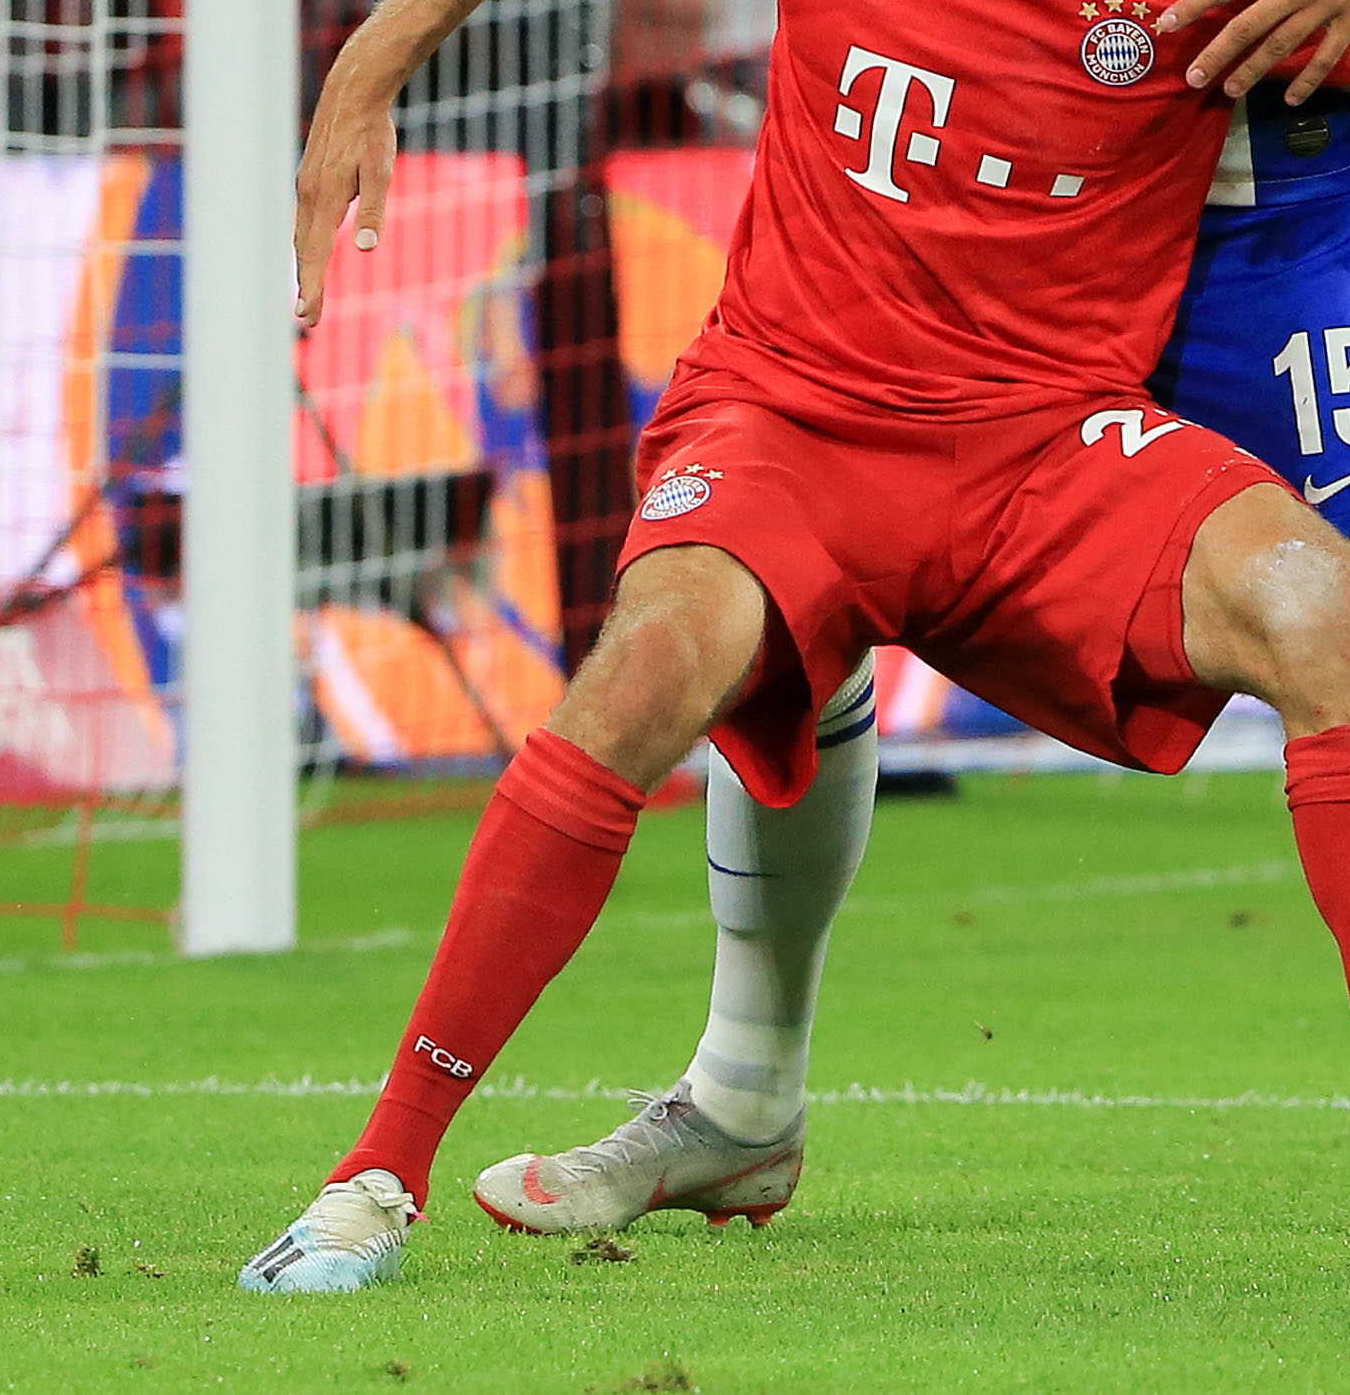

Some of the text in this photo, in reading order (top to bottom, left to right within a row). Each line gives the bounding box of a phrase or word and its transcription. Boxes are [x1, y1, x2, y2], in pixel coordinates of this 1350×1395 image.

[1089, 23, 1150, 55] FC BAYERN
[1081, 408, 1196, 458] 2
[414, 1035, 473, 1078] FCB
